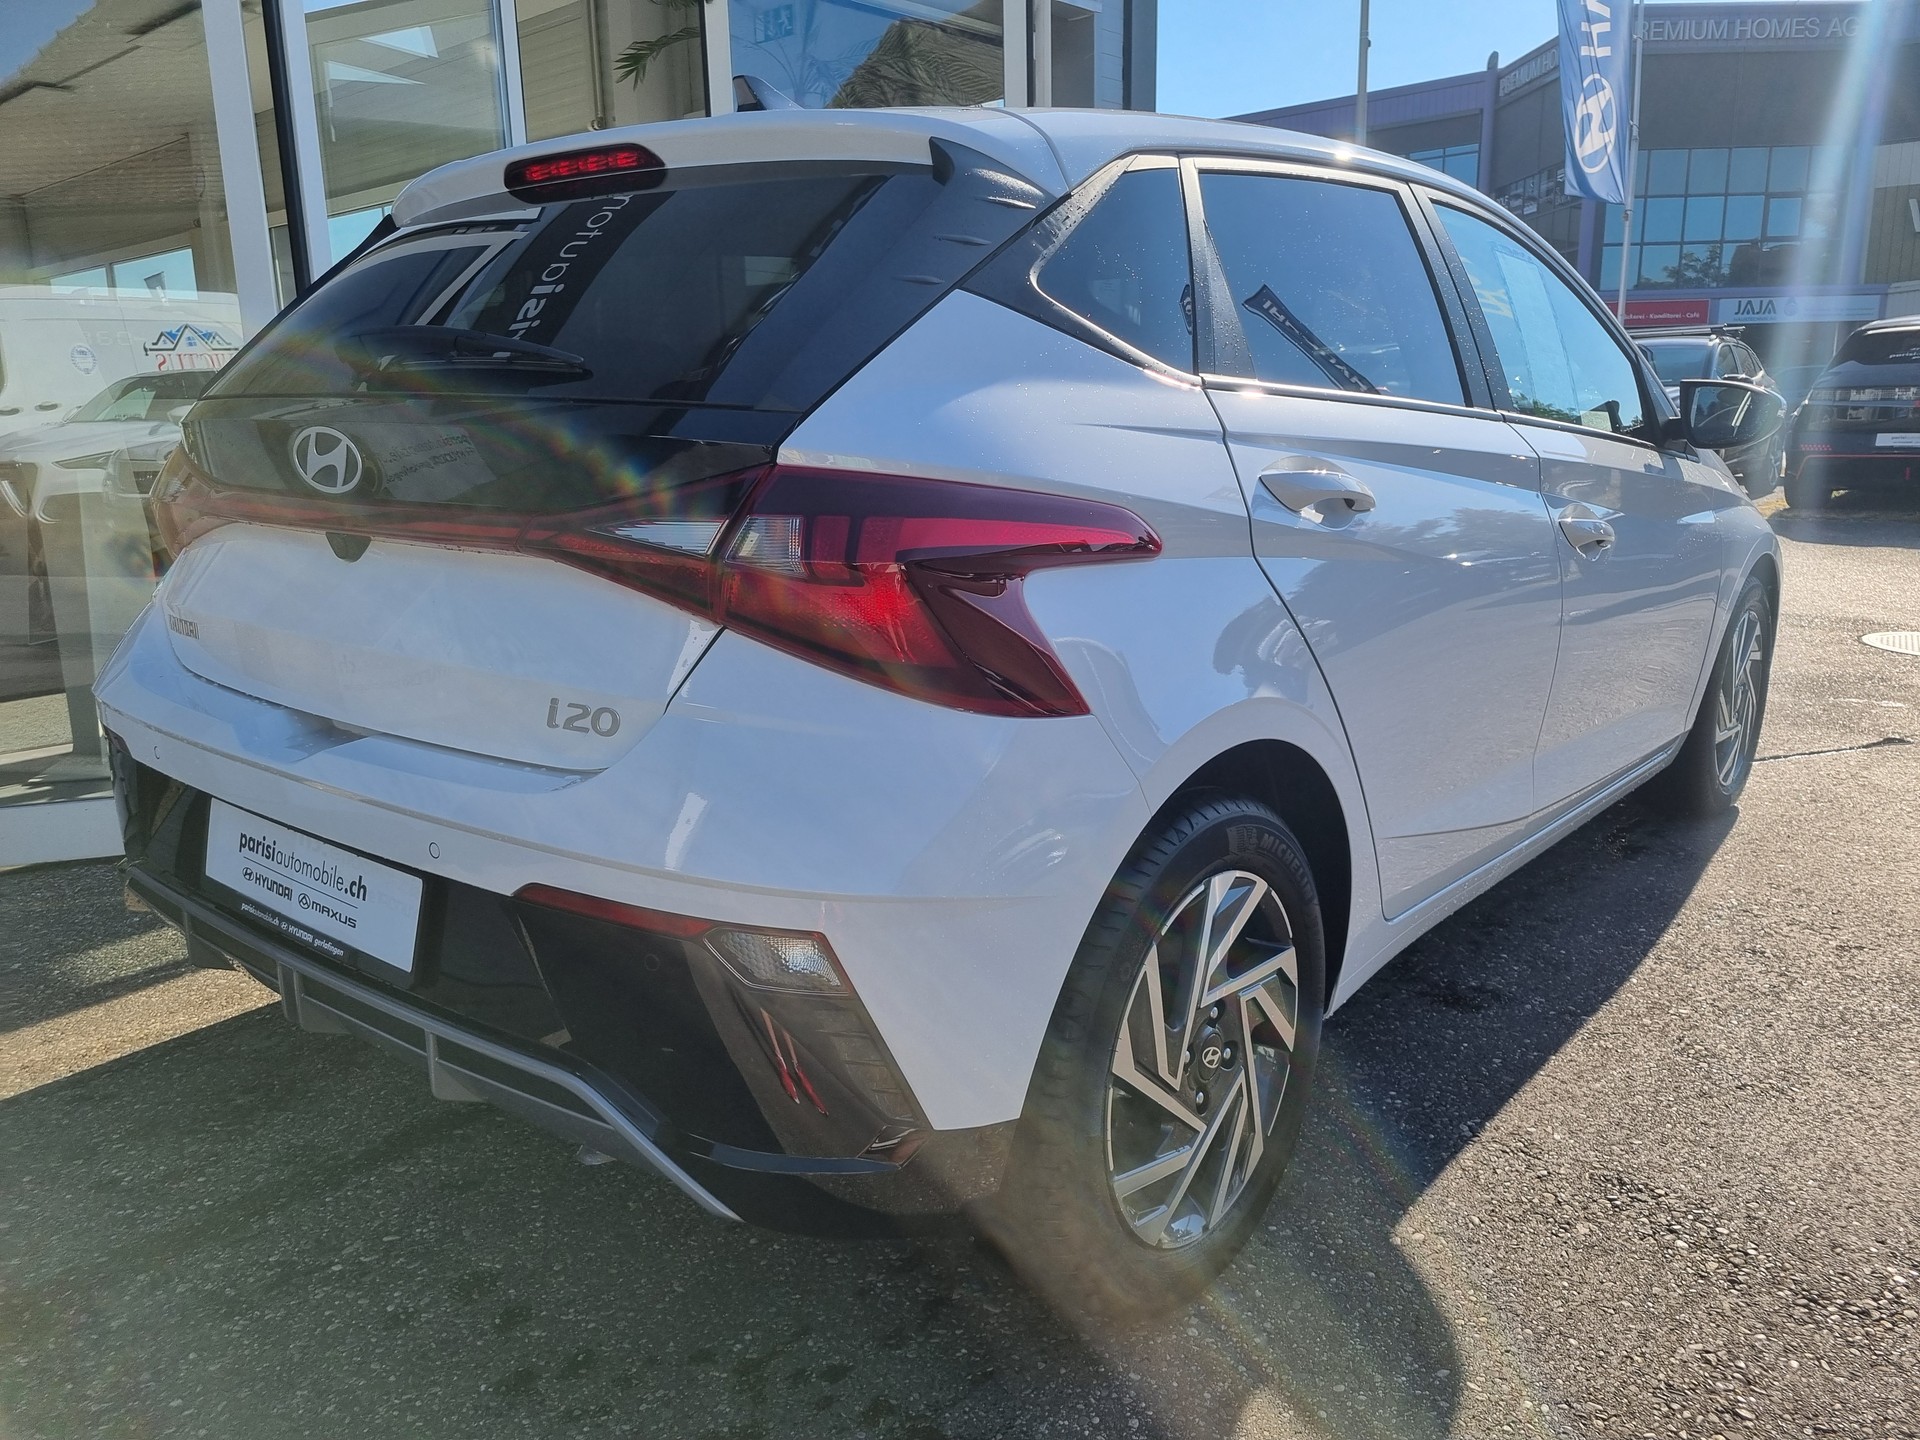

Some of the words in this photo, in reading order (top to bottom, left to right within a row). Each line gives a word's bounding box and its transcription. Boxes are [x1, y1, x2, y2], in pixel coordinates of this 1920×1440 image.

[1735, 17, 1820, 39] HOMES
[1825, 17, 1860, 38] AG
[1734, 299, 1777, 315] JAJA
[547, 698, 621, 737] i20
[239, 832, 367, 901] parisiautomobile.ch
[255, 872, 293, 901] HYUNDAI
[311, 901, 357, 929] MAXUS
[288, 924, 313, 944] HYUNDAI
